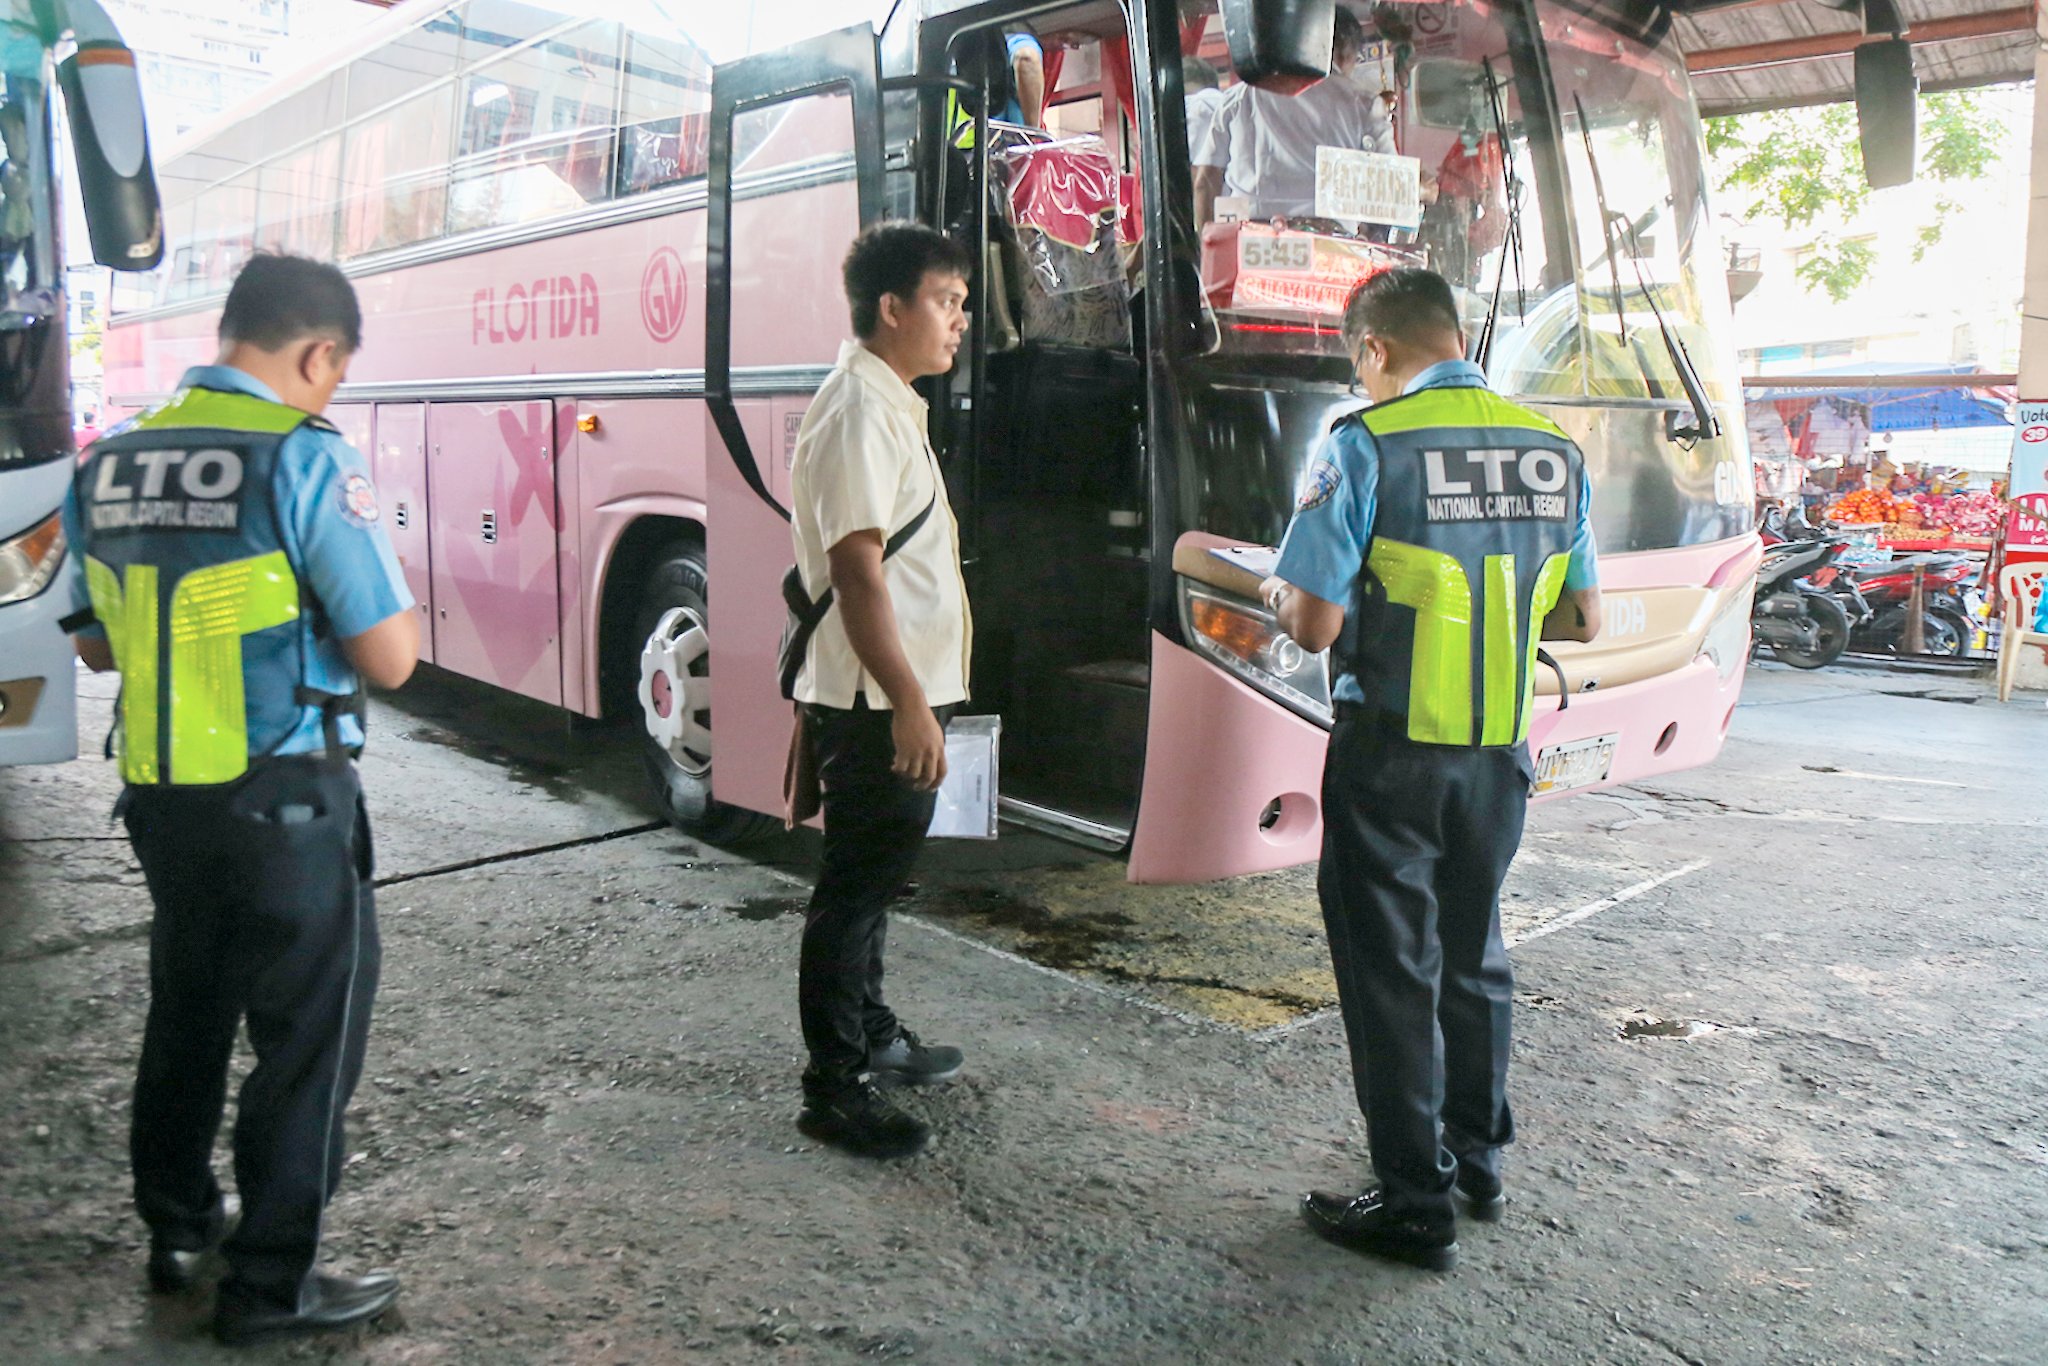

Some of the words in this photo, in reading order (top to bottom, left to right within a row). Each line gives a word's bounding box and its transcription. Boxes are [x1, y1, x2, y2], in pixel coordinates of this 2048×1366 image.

[1244, 242, 1309, 266] 5:45
[472, 272, 600, 346] FLORIDA
[95, 449, 243, 501] LTO
[1424, 449, 1567, 496] LTO
[186, 501, 238, 528] REGION
[1426, 497, 1484, 520] NATIONAL
[1485, 495, 1532, 518] CAPITAL
[1533, 495, 1565, 518] REGION
